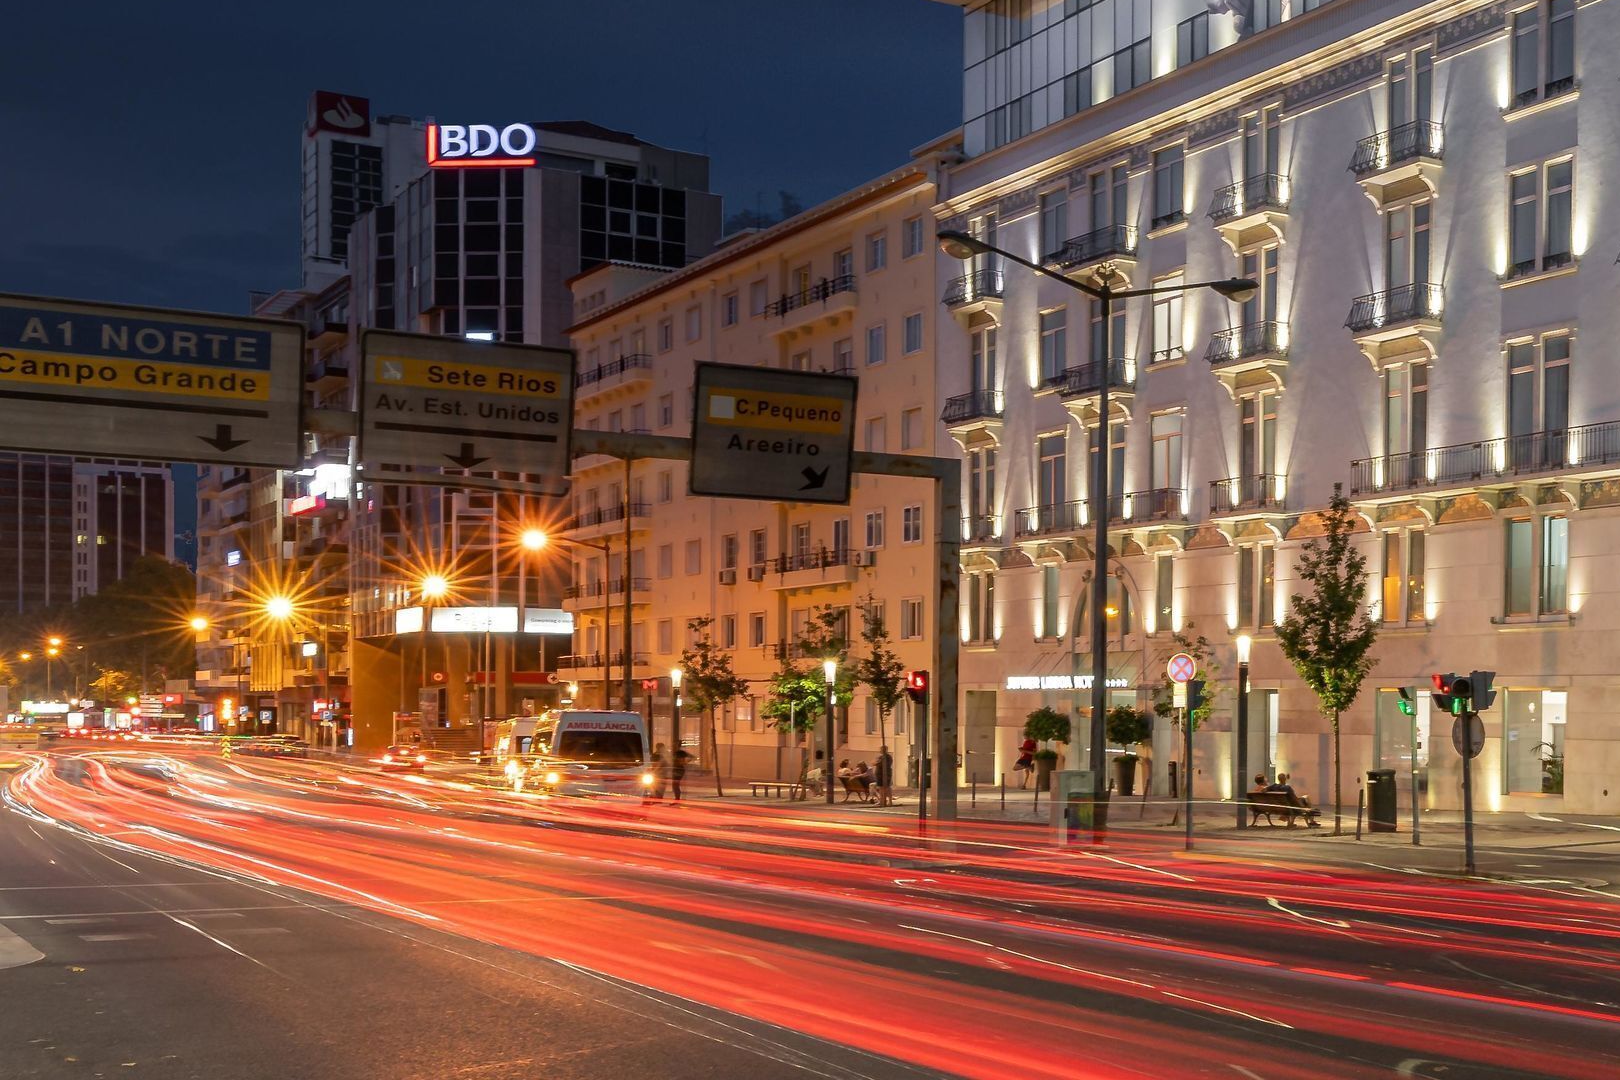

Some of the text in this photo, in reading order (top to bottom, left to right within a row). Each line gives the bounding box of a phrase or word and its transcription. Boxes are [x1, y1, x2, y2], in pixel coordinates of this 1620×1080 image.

[440, 123, 536, 157] BDO
[20, 317, 258, 363] A1 NORTE
[0, 352, 257, 394] Campo Grande
[427, 366, 556, 393] Sete Rios
[375, 394, 559, 424] Av. Est. Unidos
[727, 434, 820, 456] Areeiro
